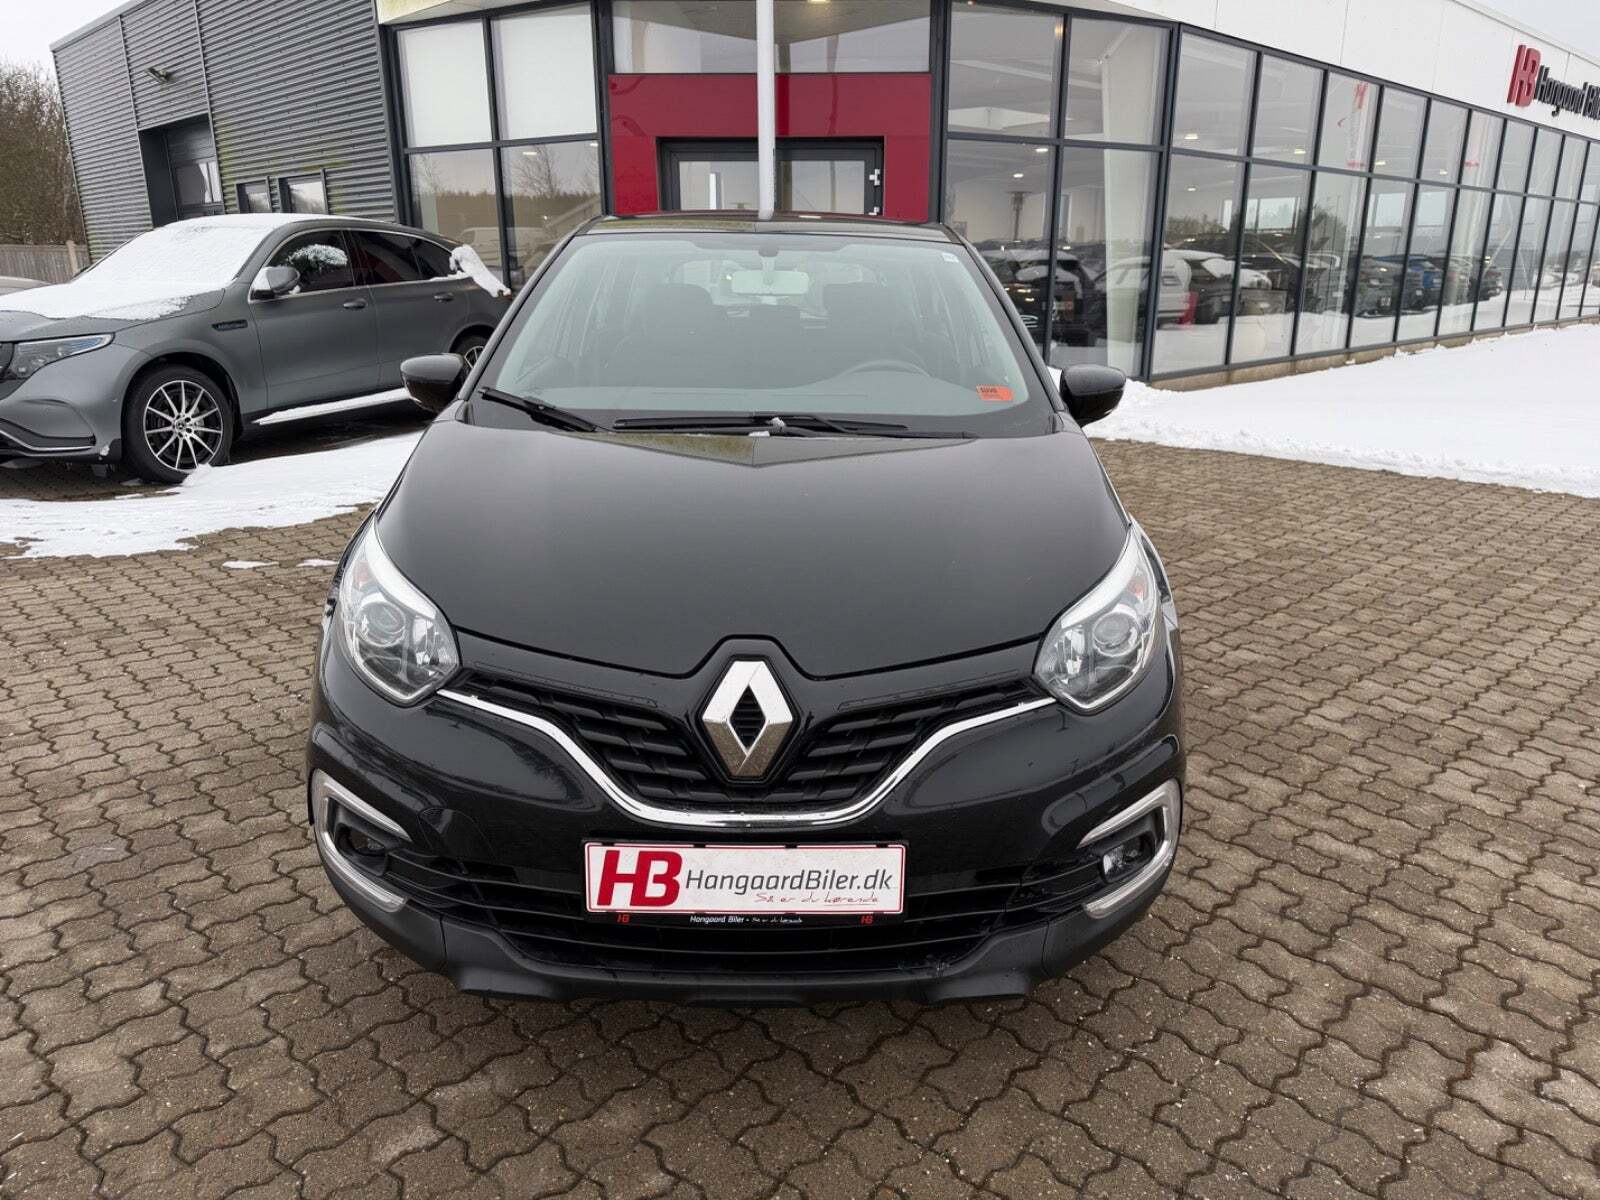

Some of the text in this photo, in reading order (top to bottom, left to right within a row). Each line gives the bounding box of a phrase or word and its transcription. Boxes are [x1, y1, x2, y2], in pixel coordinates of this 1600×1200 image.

[1507, 44, 1541, 108] HB
[597, 850, 683, 907] HB
[686, 868, 893, 896] HangaardBiler.dk
